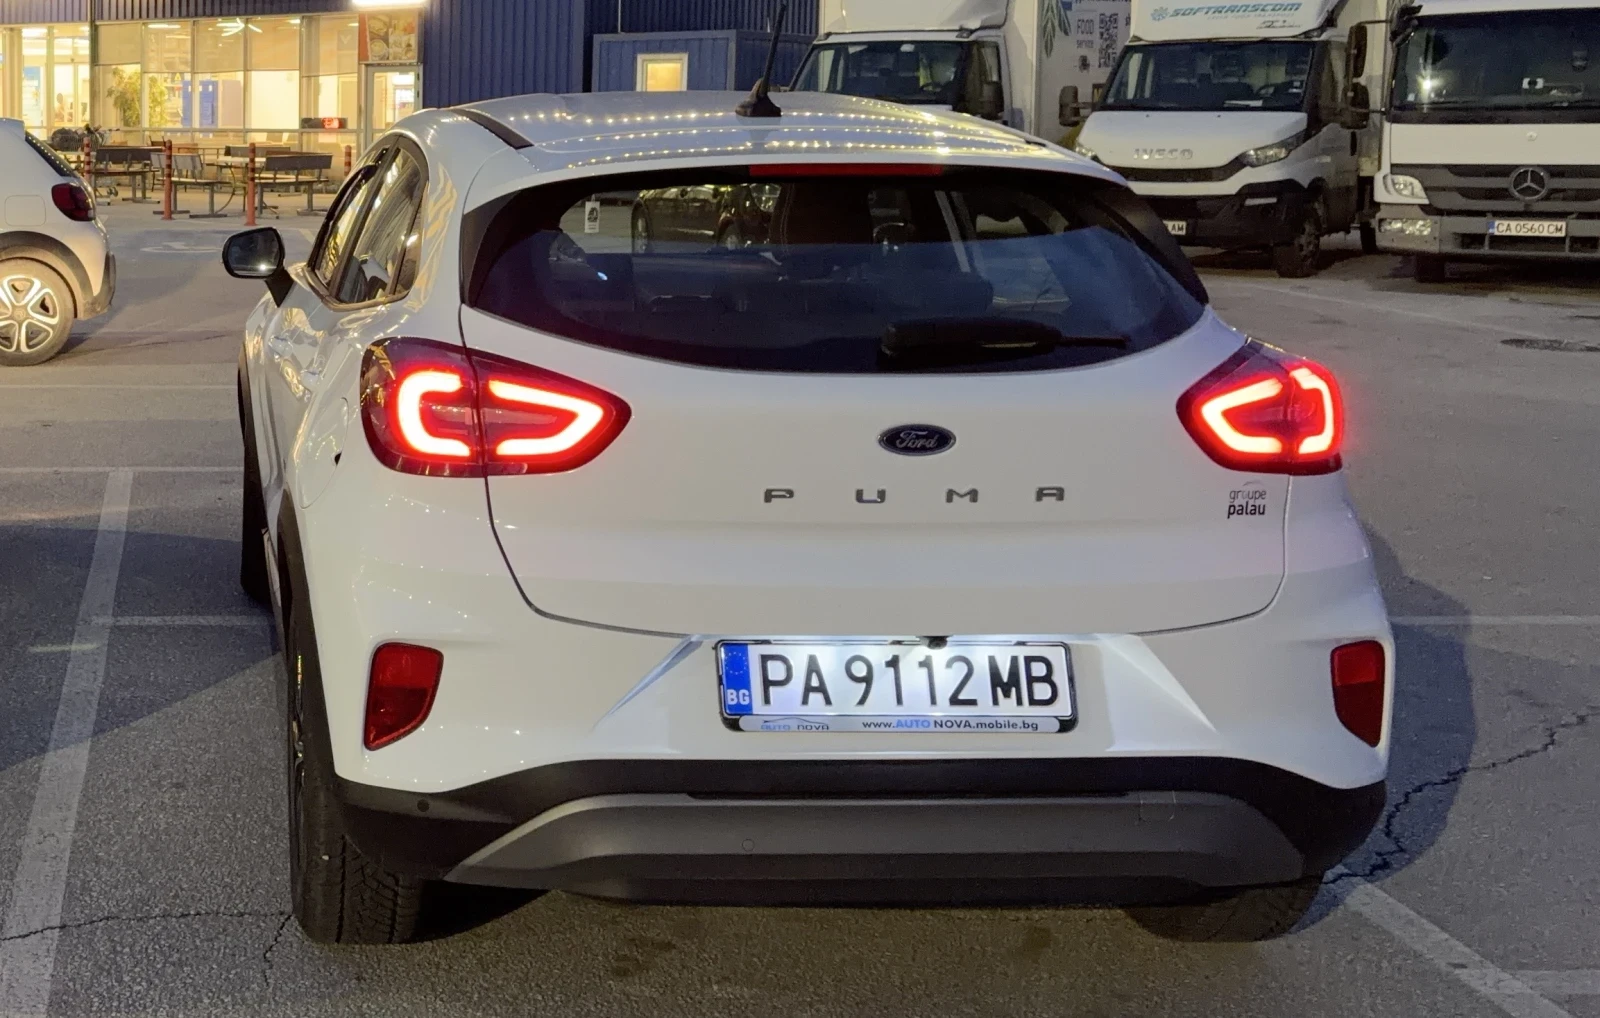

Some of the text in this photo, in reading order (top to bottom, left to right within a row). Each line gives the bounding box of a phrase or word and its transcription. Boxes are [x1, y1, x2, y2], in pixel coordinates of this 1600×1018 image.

[1169, 2, 1303, 18] SOFTRANSCOM
[1133, 148, 1194, 160] IVECO
[1496, 223, 1512, 233] CA
[1515, 223, 1545, 234] 0560
[1547, 224, 1564, 234] CM
[896, 430, 939, 448] Ford
[763, 486, 1066, 503] PUMA
[1229, 490, 1267, 503] groupe
[1227, 500, 1266, 519] palau
[726, 690, 750, 706] BG
